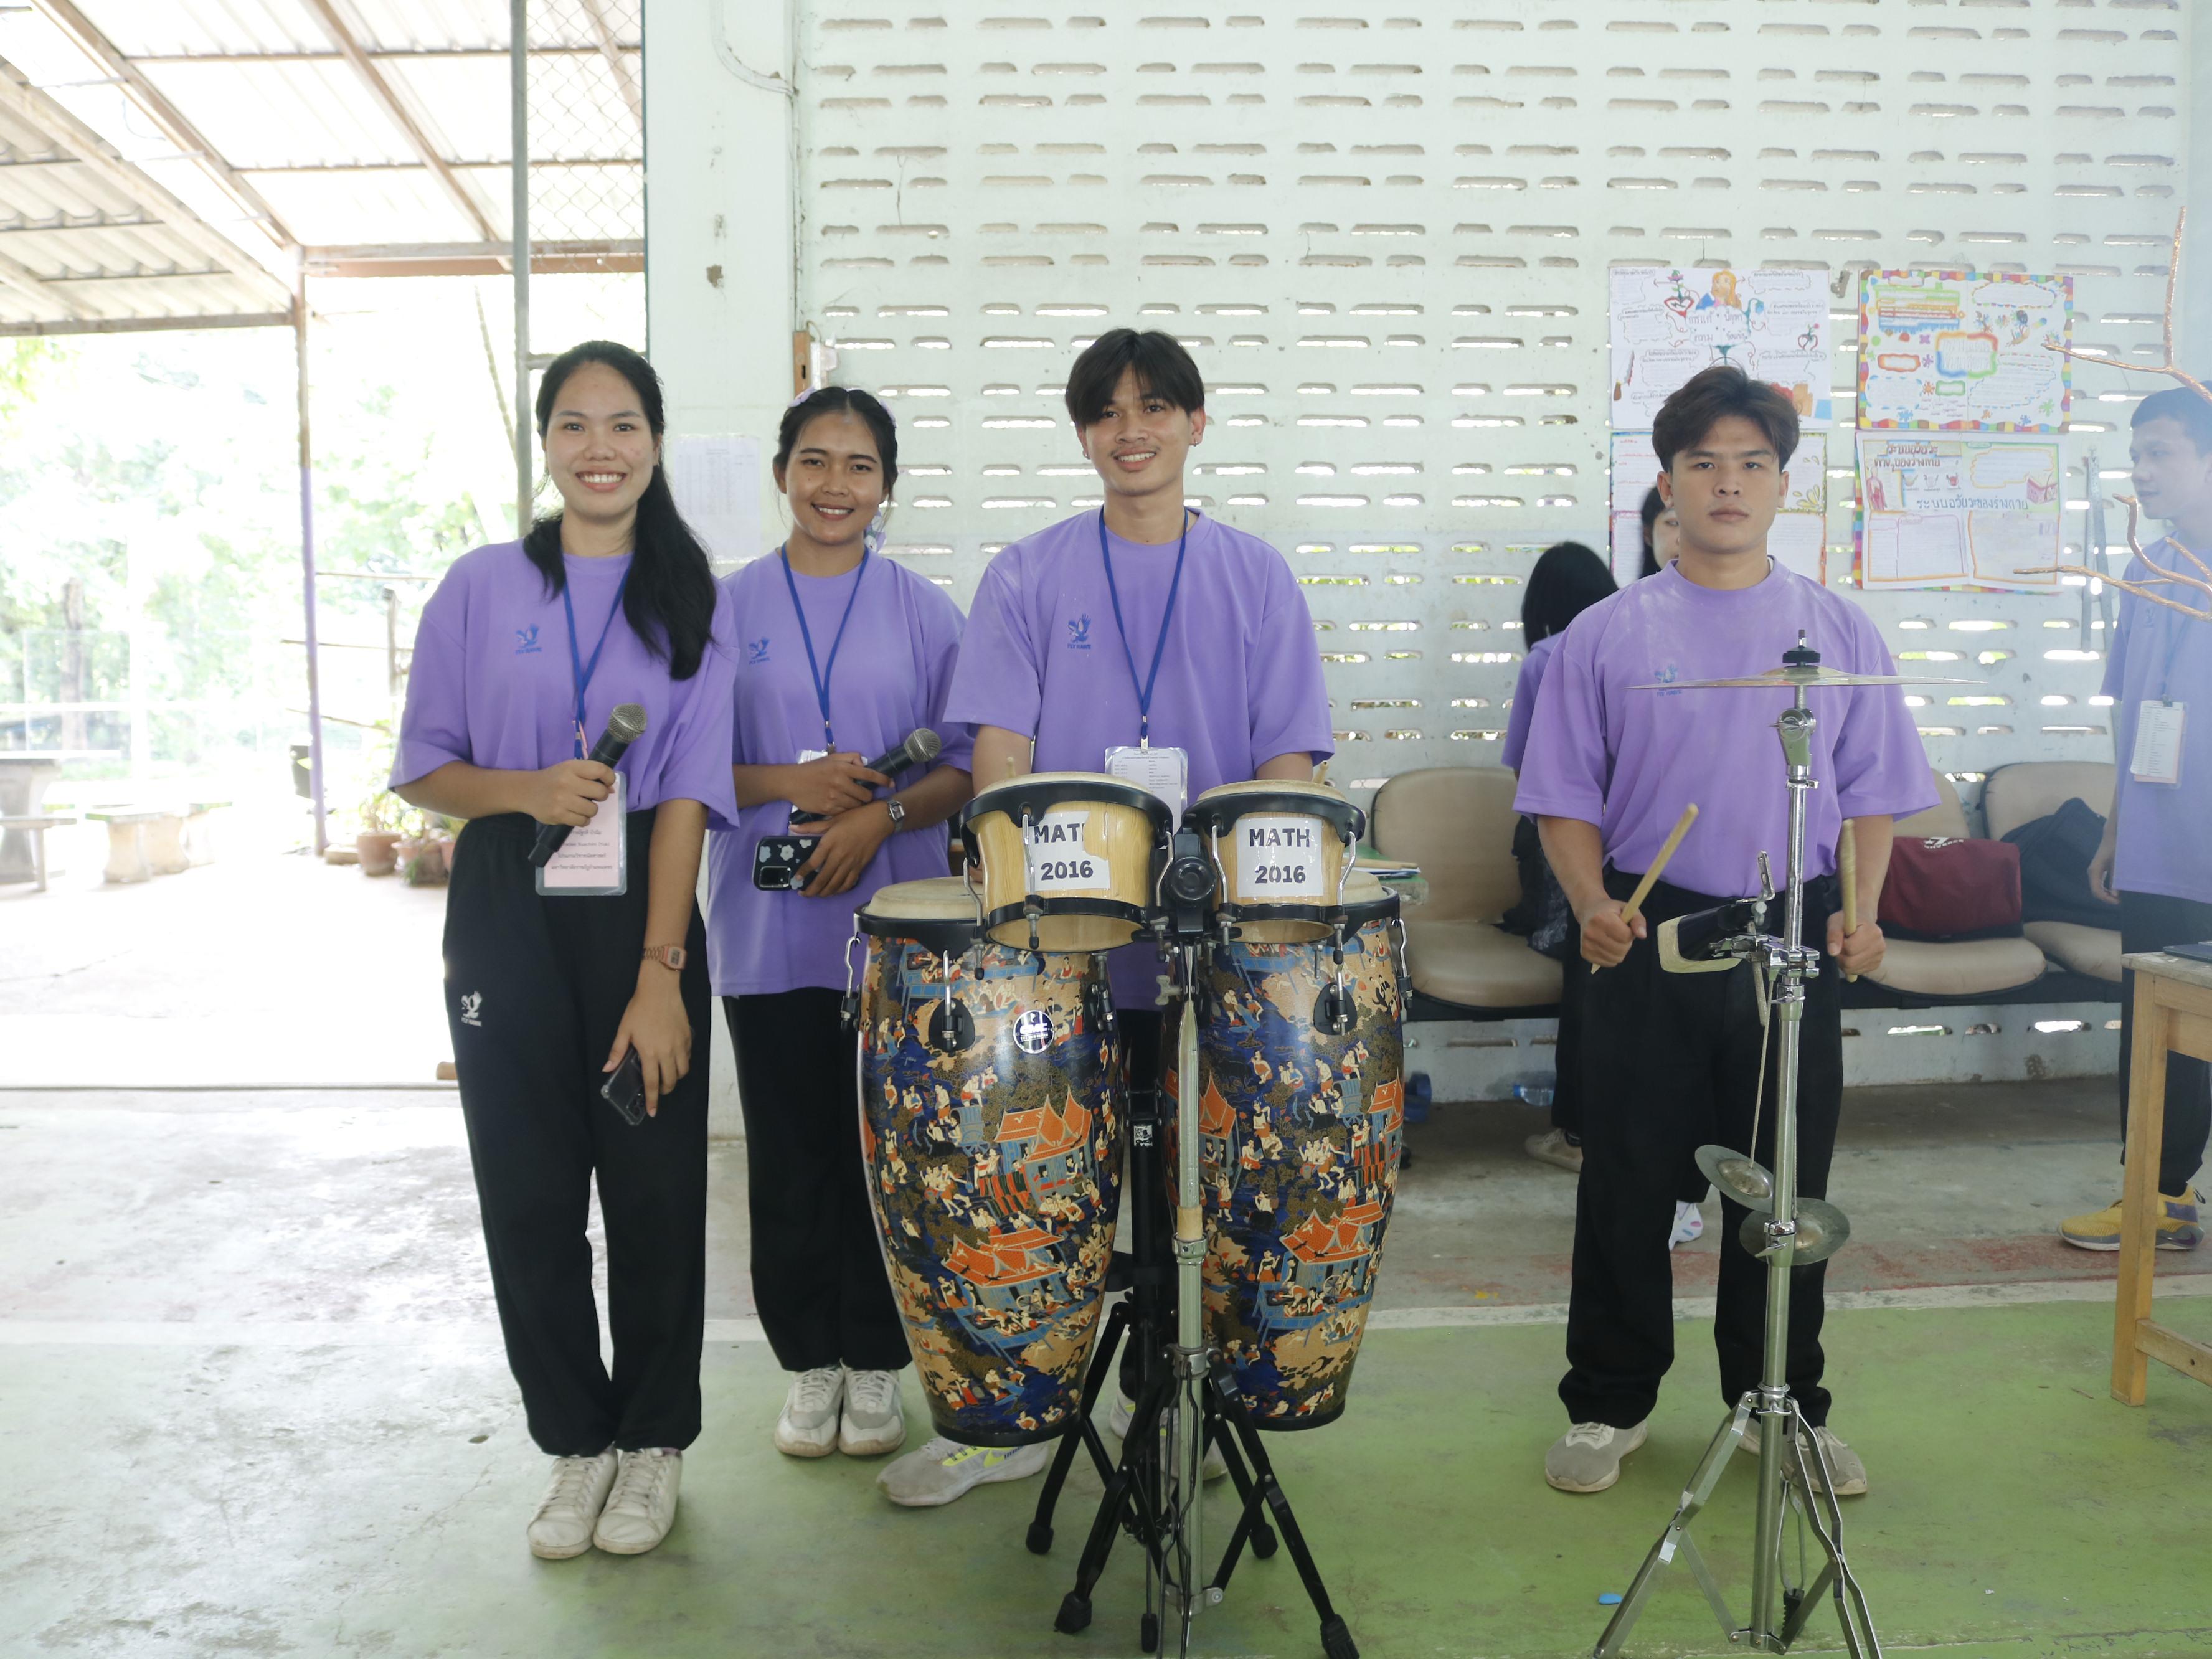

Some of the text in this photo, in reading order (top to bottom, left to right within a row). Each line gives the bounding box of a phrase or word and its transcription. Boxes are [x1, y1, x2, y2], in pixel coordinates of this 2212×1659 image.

[1034, 823, 1085, 844] MAT
[1249, 828, 1310, 848] MATH
[1041, 860, 1094, 881] 2016
[1255, 866, 1306, 884] 2016
